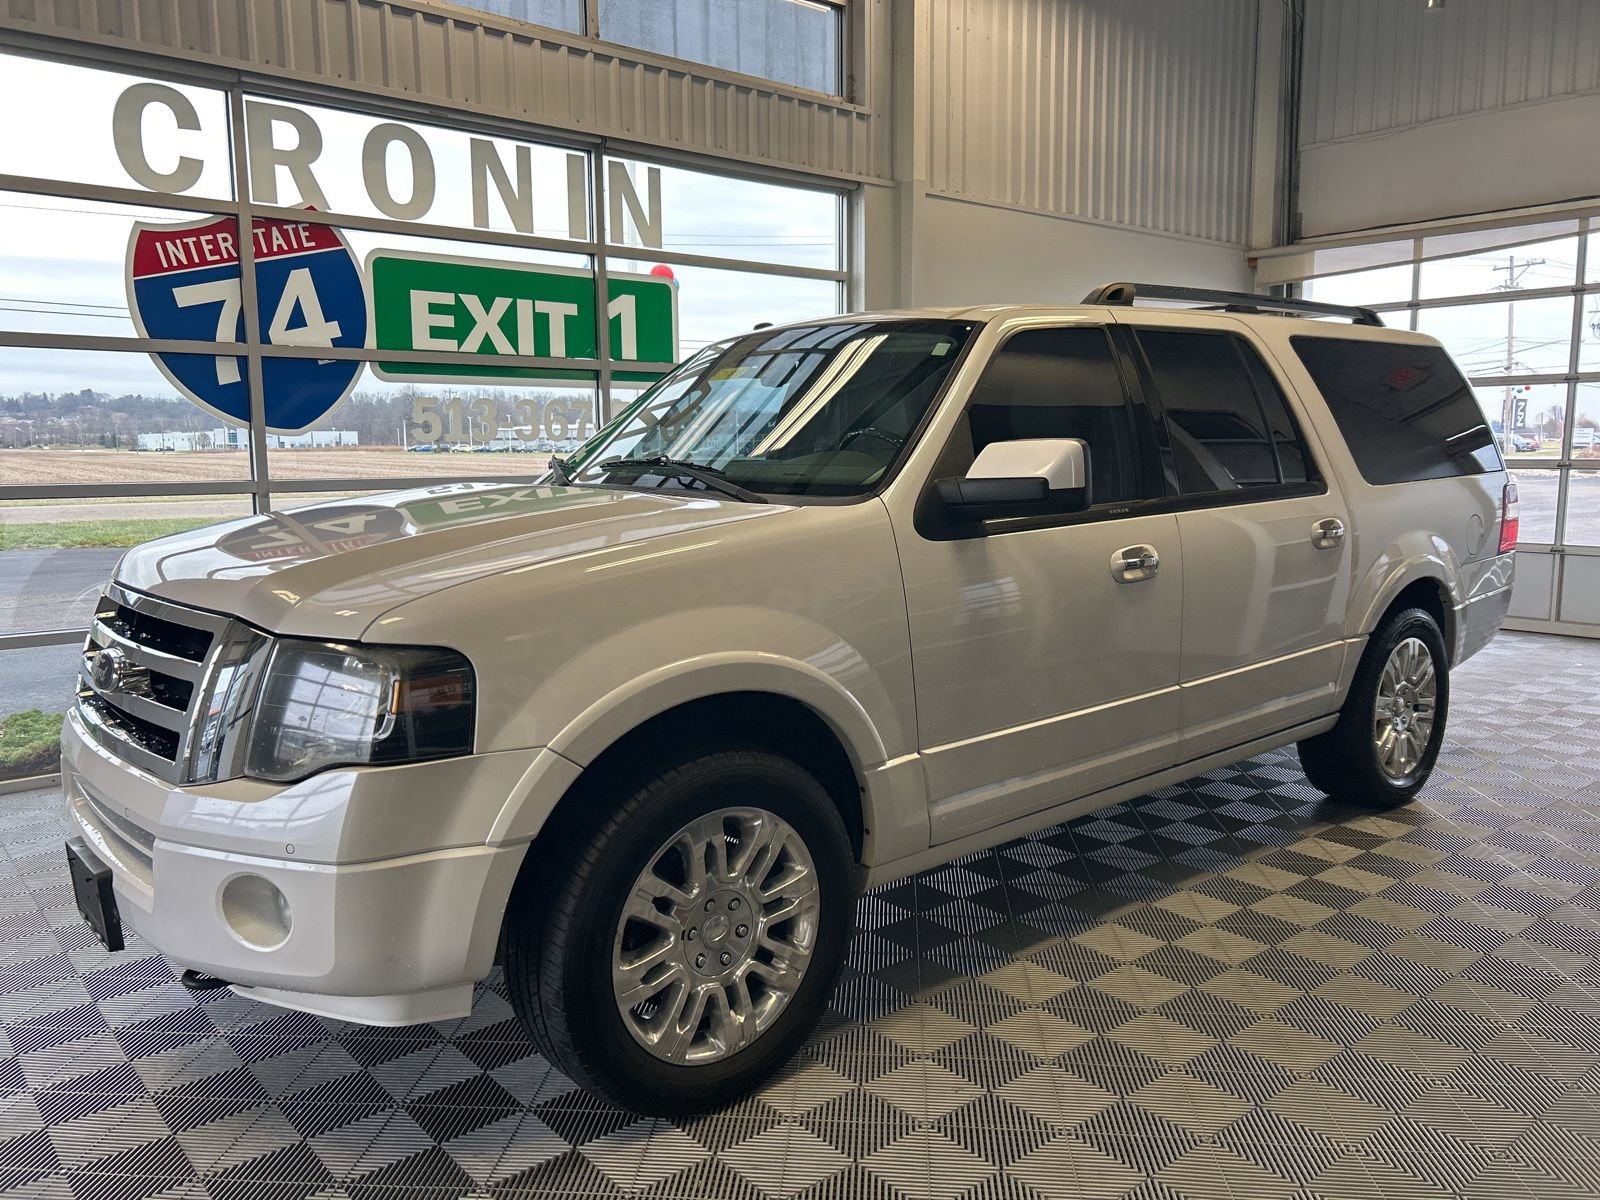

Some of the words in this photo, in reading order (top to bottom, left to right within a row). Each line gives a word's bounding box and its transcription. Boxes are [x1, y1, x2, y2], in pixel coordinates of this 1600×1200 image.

[112, 83, 662, 249] CRONIN
[155, 223, 316, 268] INTERTATE
[172, 267, 343, 386] 74
[410, 289, 578, 358] EXIT
[607, 294, 638, 361] 1
